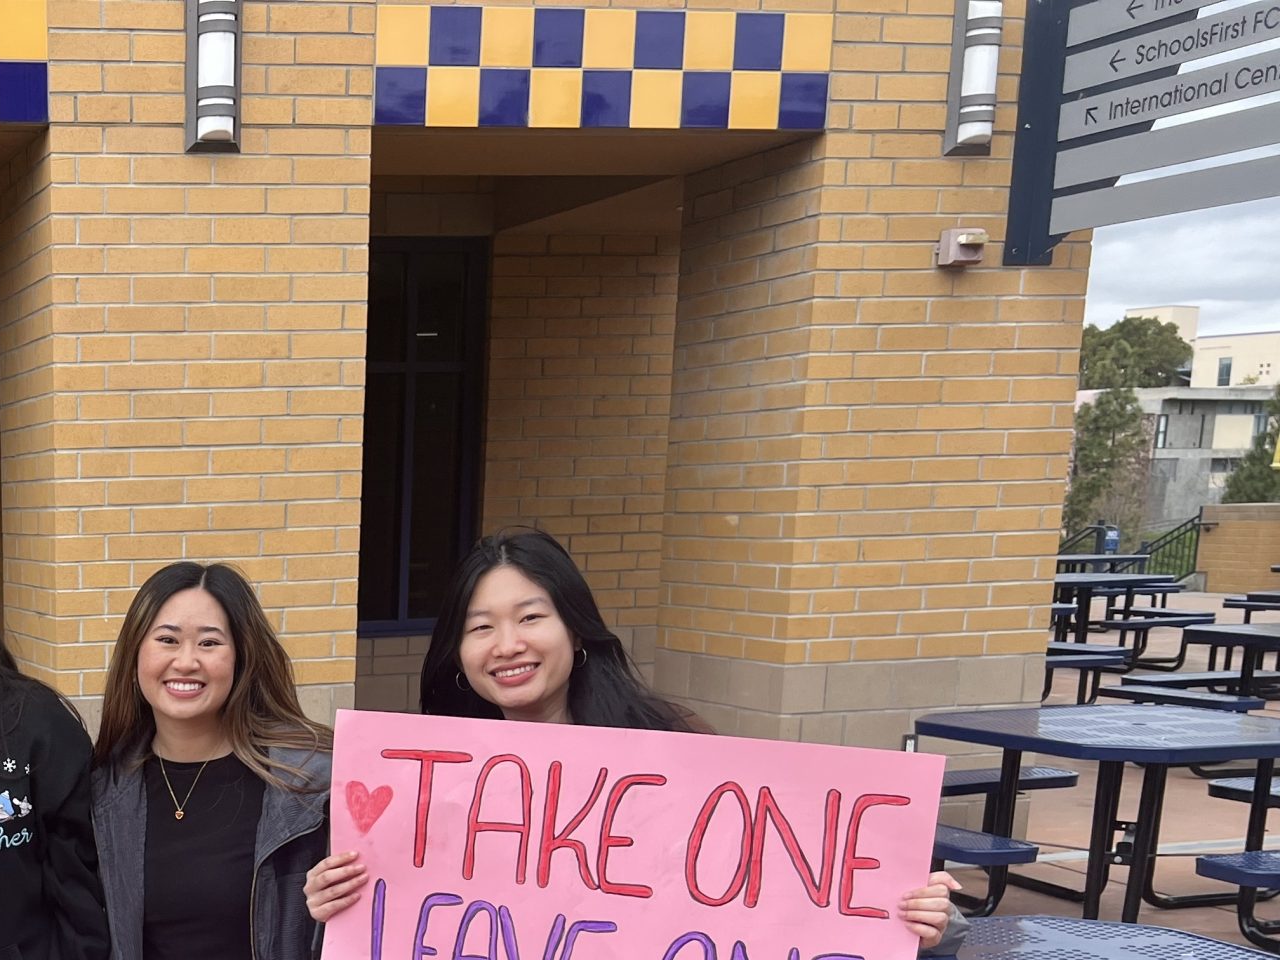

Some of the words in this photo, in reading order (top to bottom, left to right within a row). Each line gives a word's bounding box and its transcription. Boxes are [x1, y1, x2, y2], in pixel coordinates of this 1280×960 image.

[1135, 16, 1247, 65] SchoolsFirst
[1108, 72, 1229, 121] International
[1234, 64, 1280, 89] Cen
[381, 749, 667, 899] TAKE
[685, 781, 911, 919] ONE
